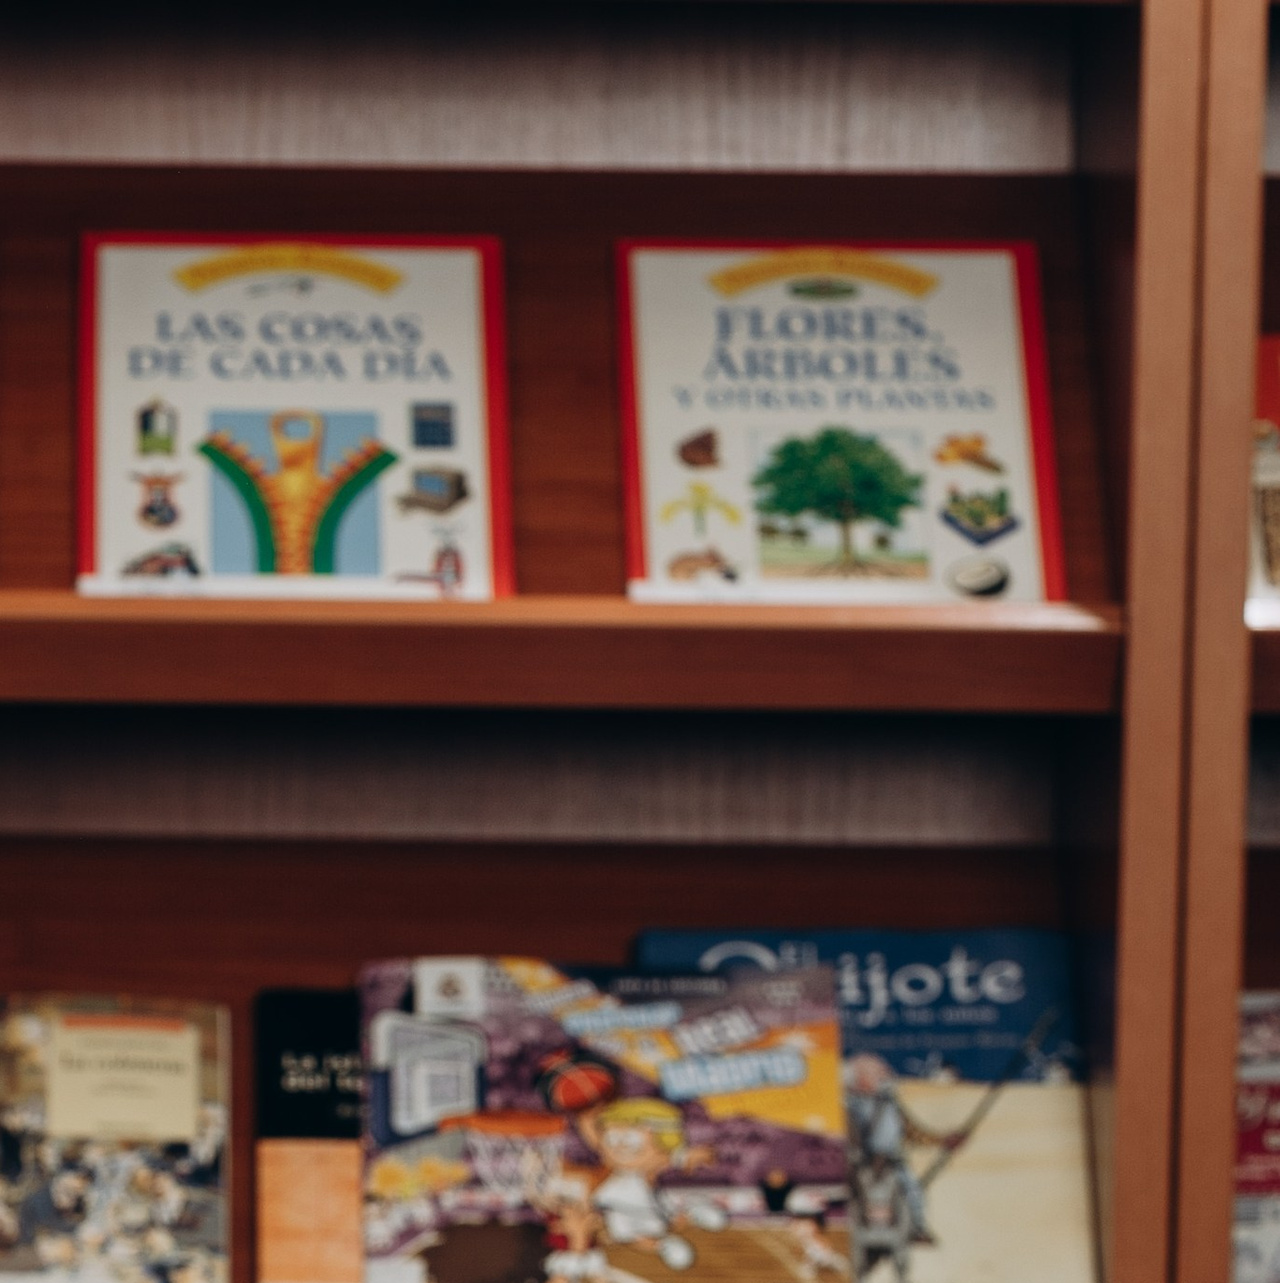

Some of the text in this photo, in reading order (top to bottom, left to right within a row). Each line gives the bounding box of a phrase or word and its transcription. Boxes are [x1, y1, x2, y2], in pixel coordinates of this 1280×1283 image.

[155, 311, 422, 347] LAS COSAS
[127, 347, 197, 380] DE
[209, 347, 348, 381] CADA
